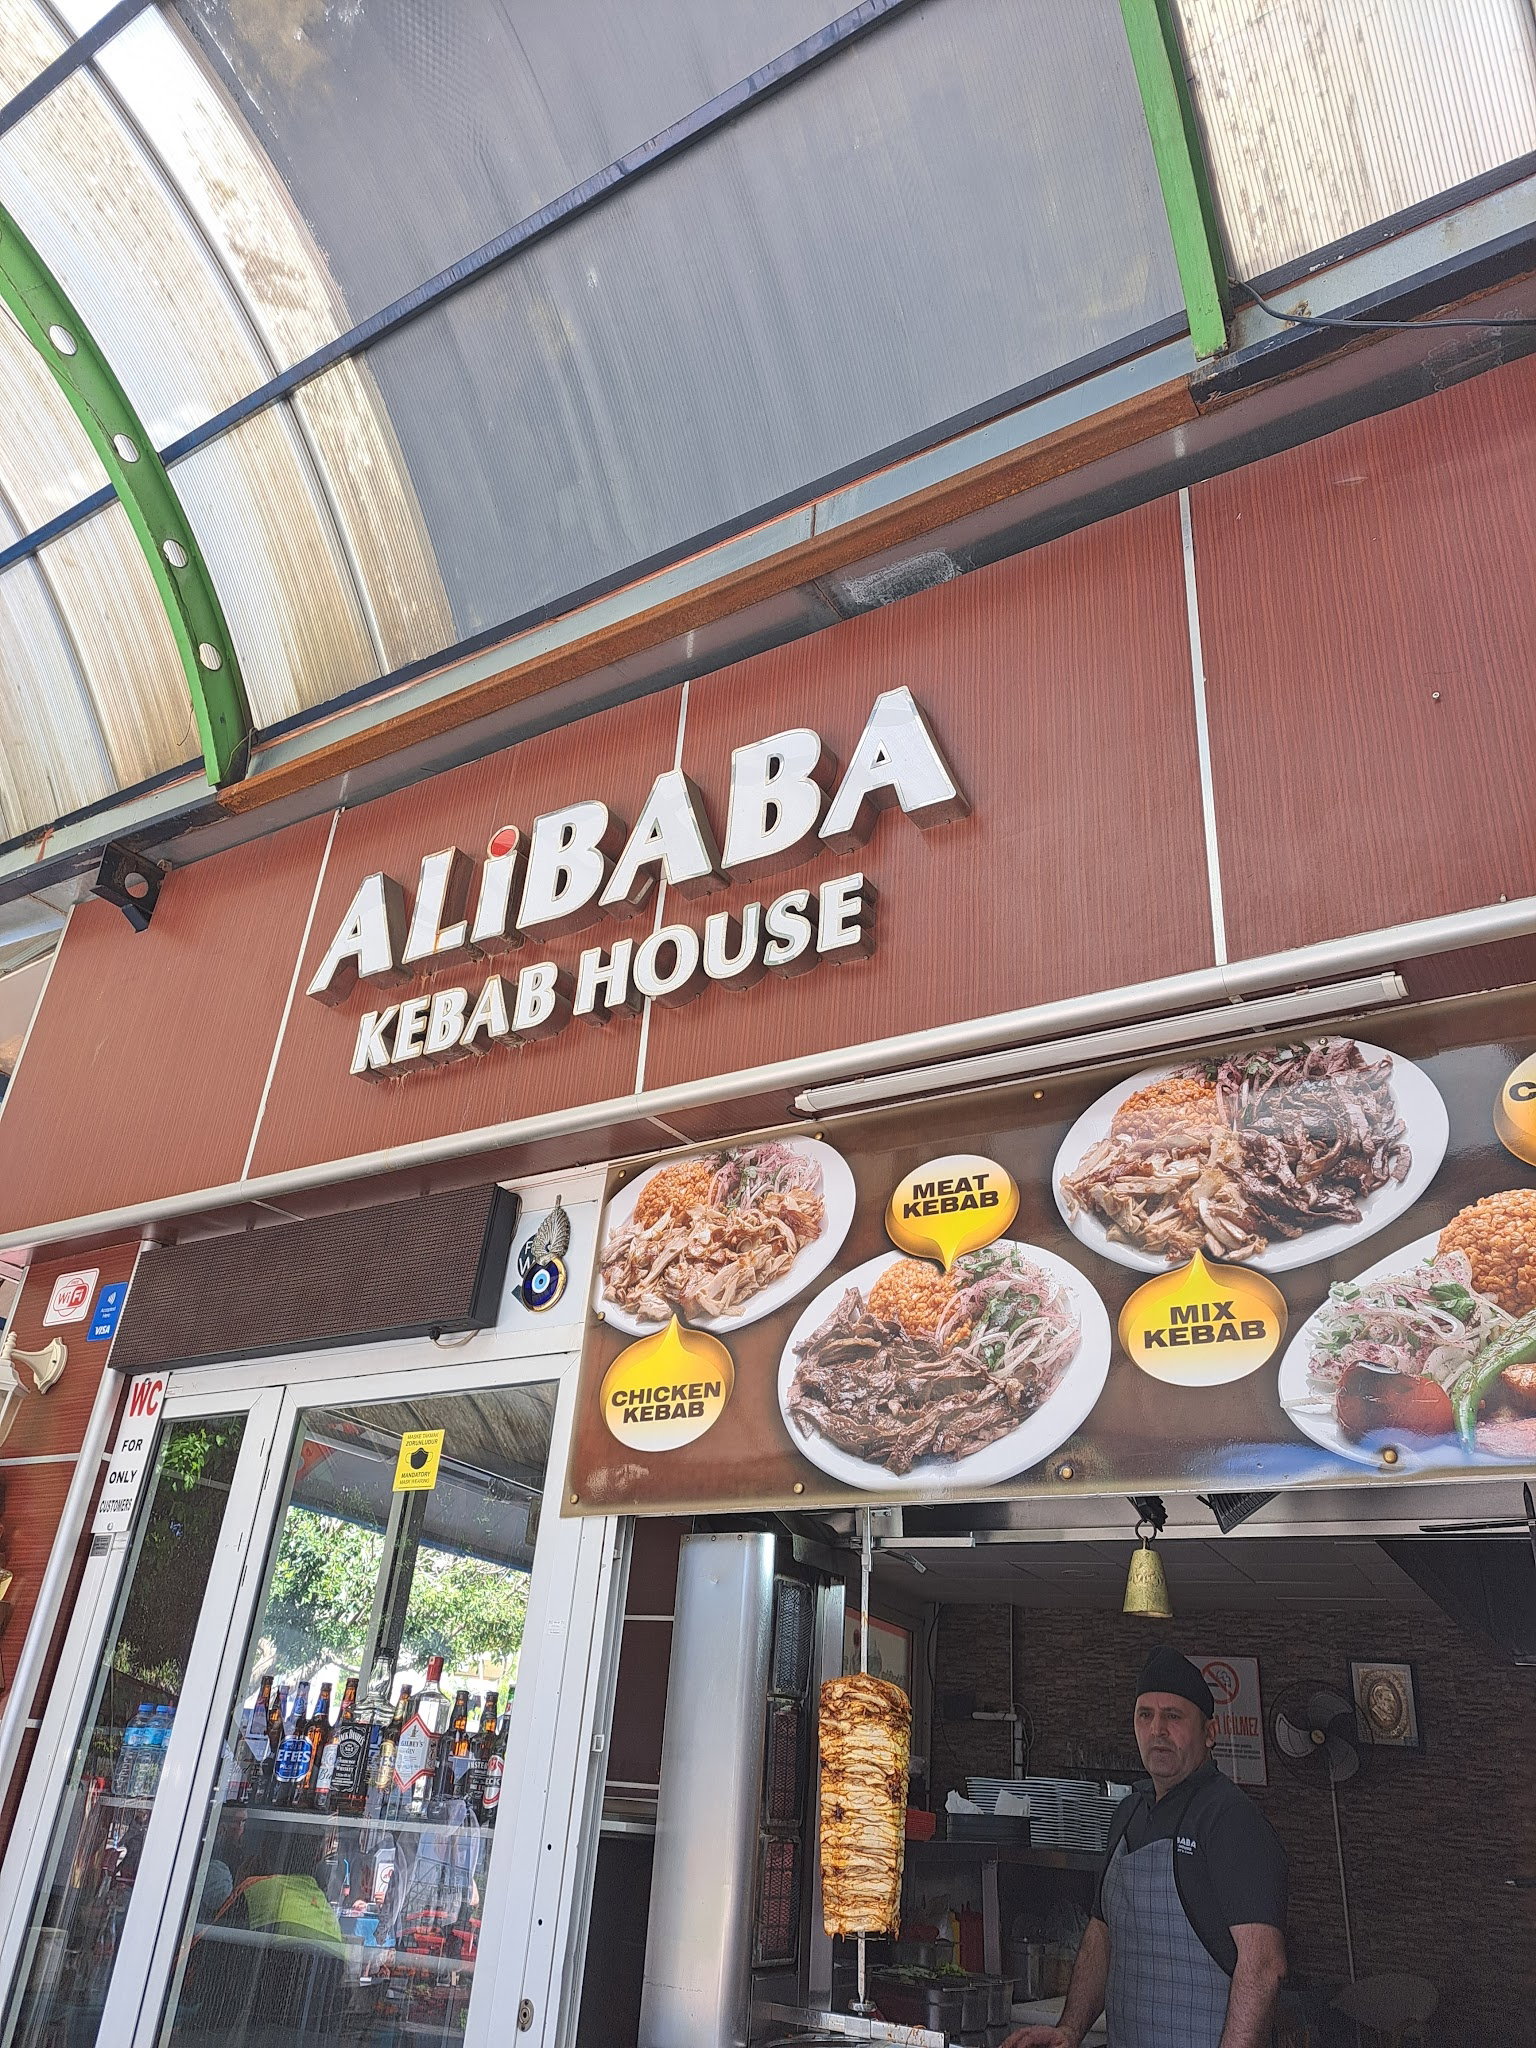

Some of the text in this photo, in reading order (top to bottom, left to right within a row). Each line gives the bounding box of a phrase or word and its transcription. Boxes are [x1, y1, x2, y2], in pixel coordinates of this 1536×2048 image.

[350, 871, 865, 1075] KEBAB HOUSE
[913, 1173, 990, 1200] MEAT
[903, 1190, 999, 1219] KEBAB
[1170, 1301, 1237, 1325] MIX
[94, 1325, 111, 1335] VISA
[1144, 1320, 1267, 1349] KEBAB
[129, 1379, 163, 1417] WC
[611, 1381, 721, 1407] CHICKEN
[623, 1401, 705, 1423] KEBAB
[121, 1439, 143, 1452] FOR
[109, 1469, 138, 1484] ONLY
[99, 1499, 132, 1513] CUSTOMERS
